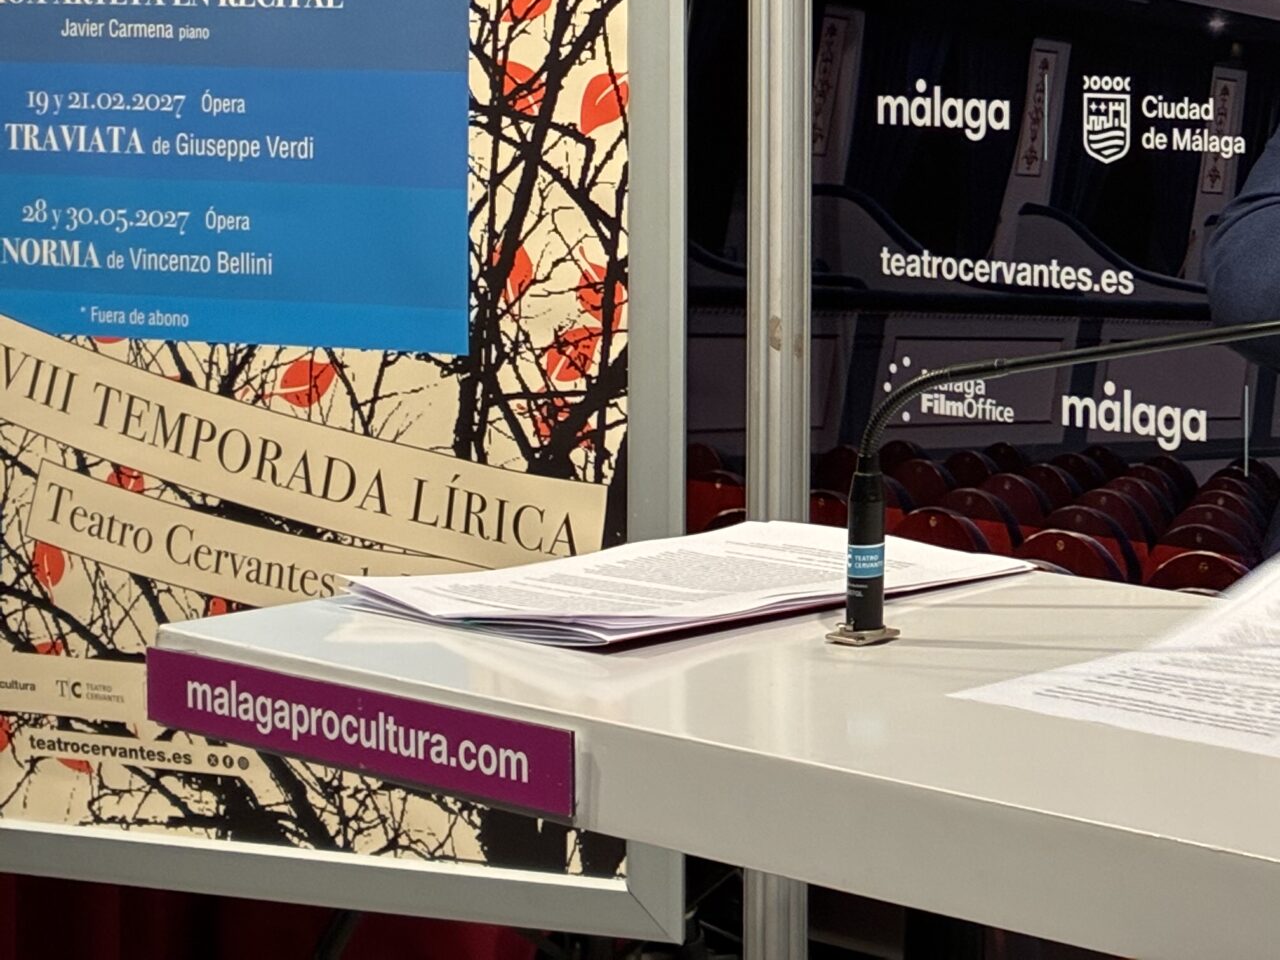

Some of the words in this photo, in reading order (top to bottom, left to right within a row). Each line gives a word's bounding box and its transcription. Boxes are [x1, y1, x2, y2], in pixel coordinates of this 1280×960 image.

[61, 18, 105, 38] Javier
[108, 20, 174, 39] Carmena
[179, 24, 210, 41] piano
[25, 90, 49, 116] 19
[53, 94, 63, 115] y
[68, 91, 186, 119] 21.02.2027
[201, 90, 246, 114] Ópera
[1142, 95, 1214, 121] Ciudad
[4, 123, 146, 154] TRAVIATA
[152, 136, 171, 156] de
[175, 136, 261, 162] Giuseppe
[266, 136, 314, 160] Verdi
[1142, 126, 1167, 151] de
[1172, 128, 1246, 159] Málaga
[22, 198, 48, 223] 28
[51, 208, 62, 231] y
[65, 206, 190, 234] 30.05.2027
[205, 206, 250, 231] Ópera
[0, 237, 102, 269] NORMA
[106, 250, 124, 270] de
[129, 248, 211, 274] Vincenzo
[217, 250, 273, 276] Bellini
[880, 246, 1134, 295] teatrocervantes.es
[90, 306, 122, 324] Fuera
[125, 307, 146, 326] de
[149, 308, 189, 327] abono
[921, 393, 1015, 423] FilmOffice
[93, 381, 392, 518] TEMPORADA
[408, 473, 578, 558] LÍRICA
[46, 482, 153, 554] Teatro
[165, 525, 335, 598] Cervantes
[86, 683, 112, 693] TEATRO
[86, 692, 125, 703] CERVANTES
[186, 677, 529, 784] malagaprocultura.com
[29, 734, 192, 766] teatrocervantes.es
